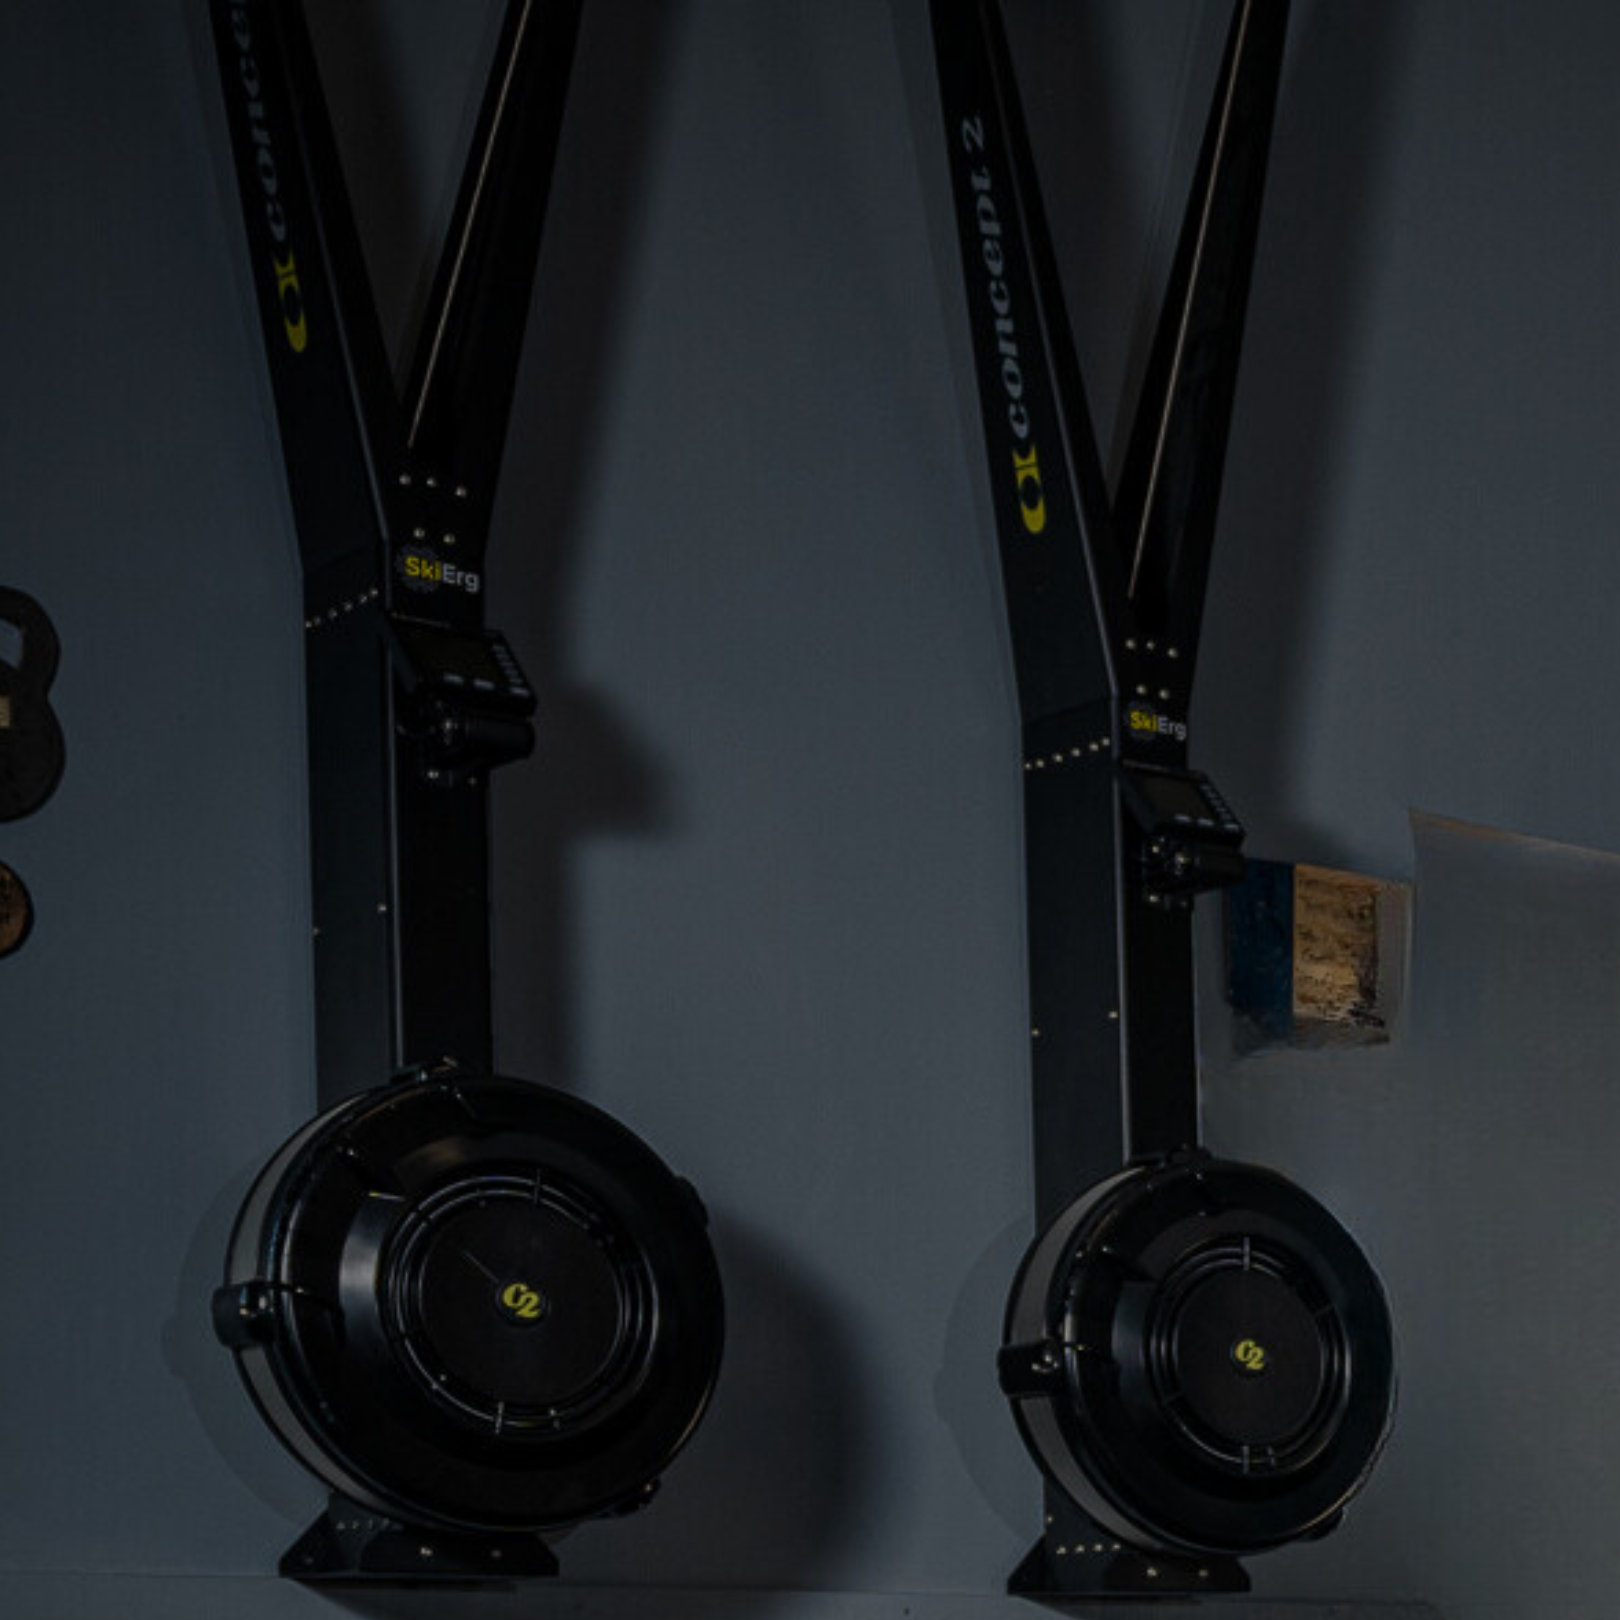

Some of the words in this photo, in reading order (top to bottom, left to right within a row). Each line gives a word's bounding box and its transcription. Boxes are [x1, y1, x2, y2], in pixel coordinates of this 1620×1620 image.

[958, 110, 985, 150] 2
[970, 160, 1031, 440] concept
[404, 555, 480, 594] SkiErg
[1129, 710, 1187, 741] SkiErg
[503, 1283, 541, 1318] C2
[1235, 1338, 1265, 1370] C2
